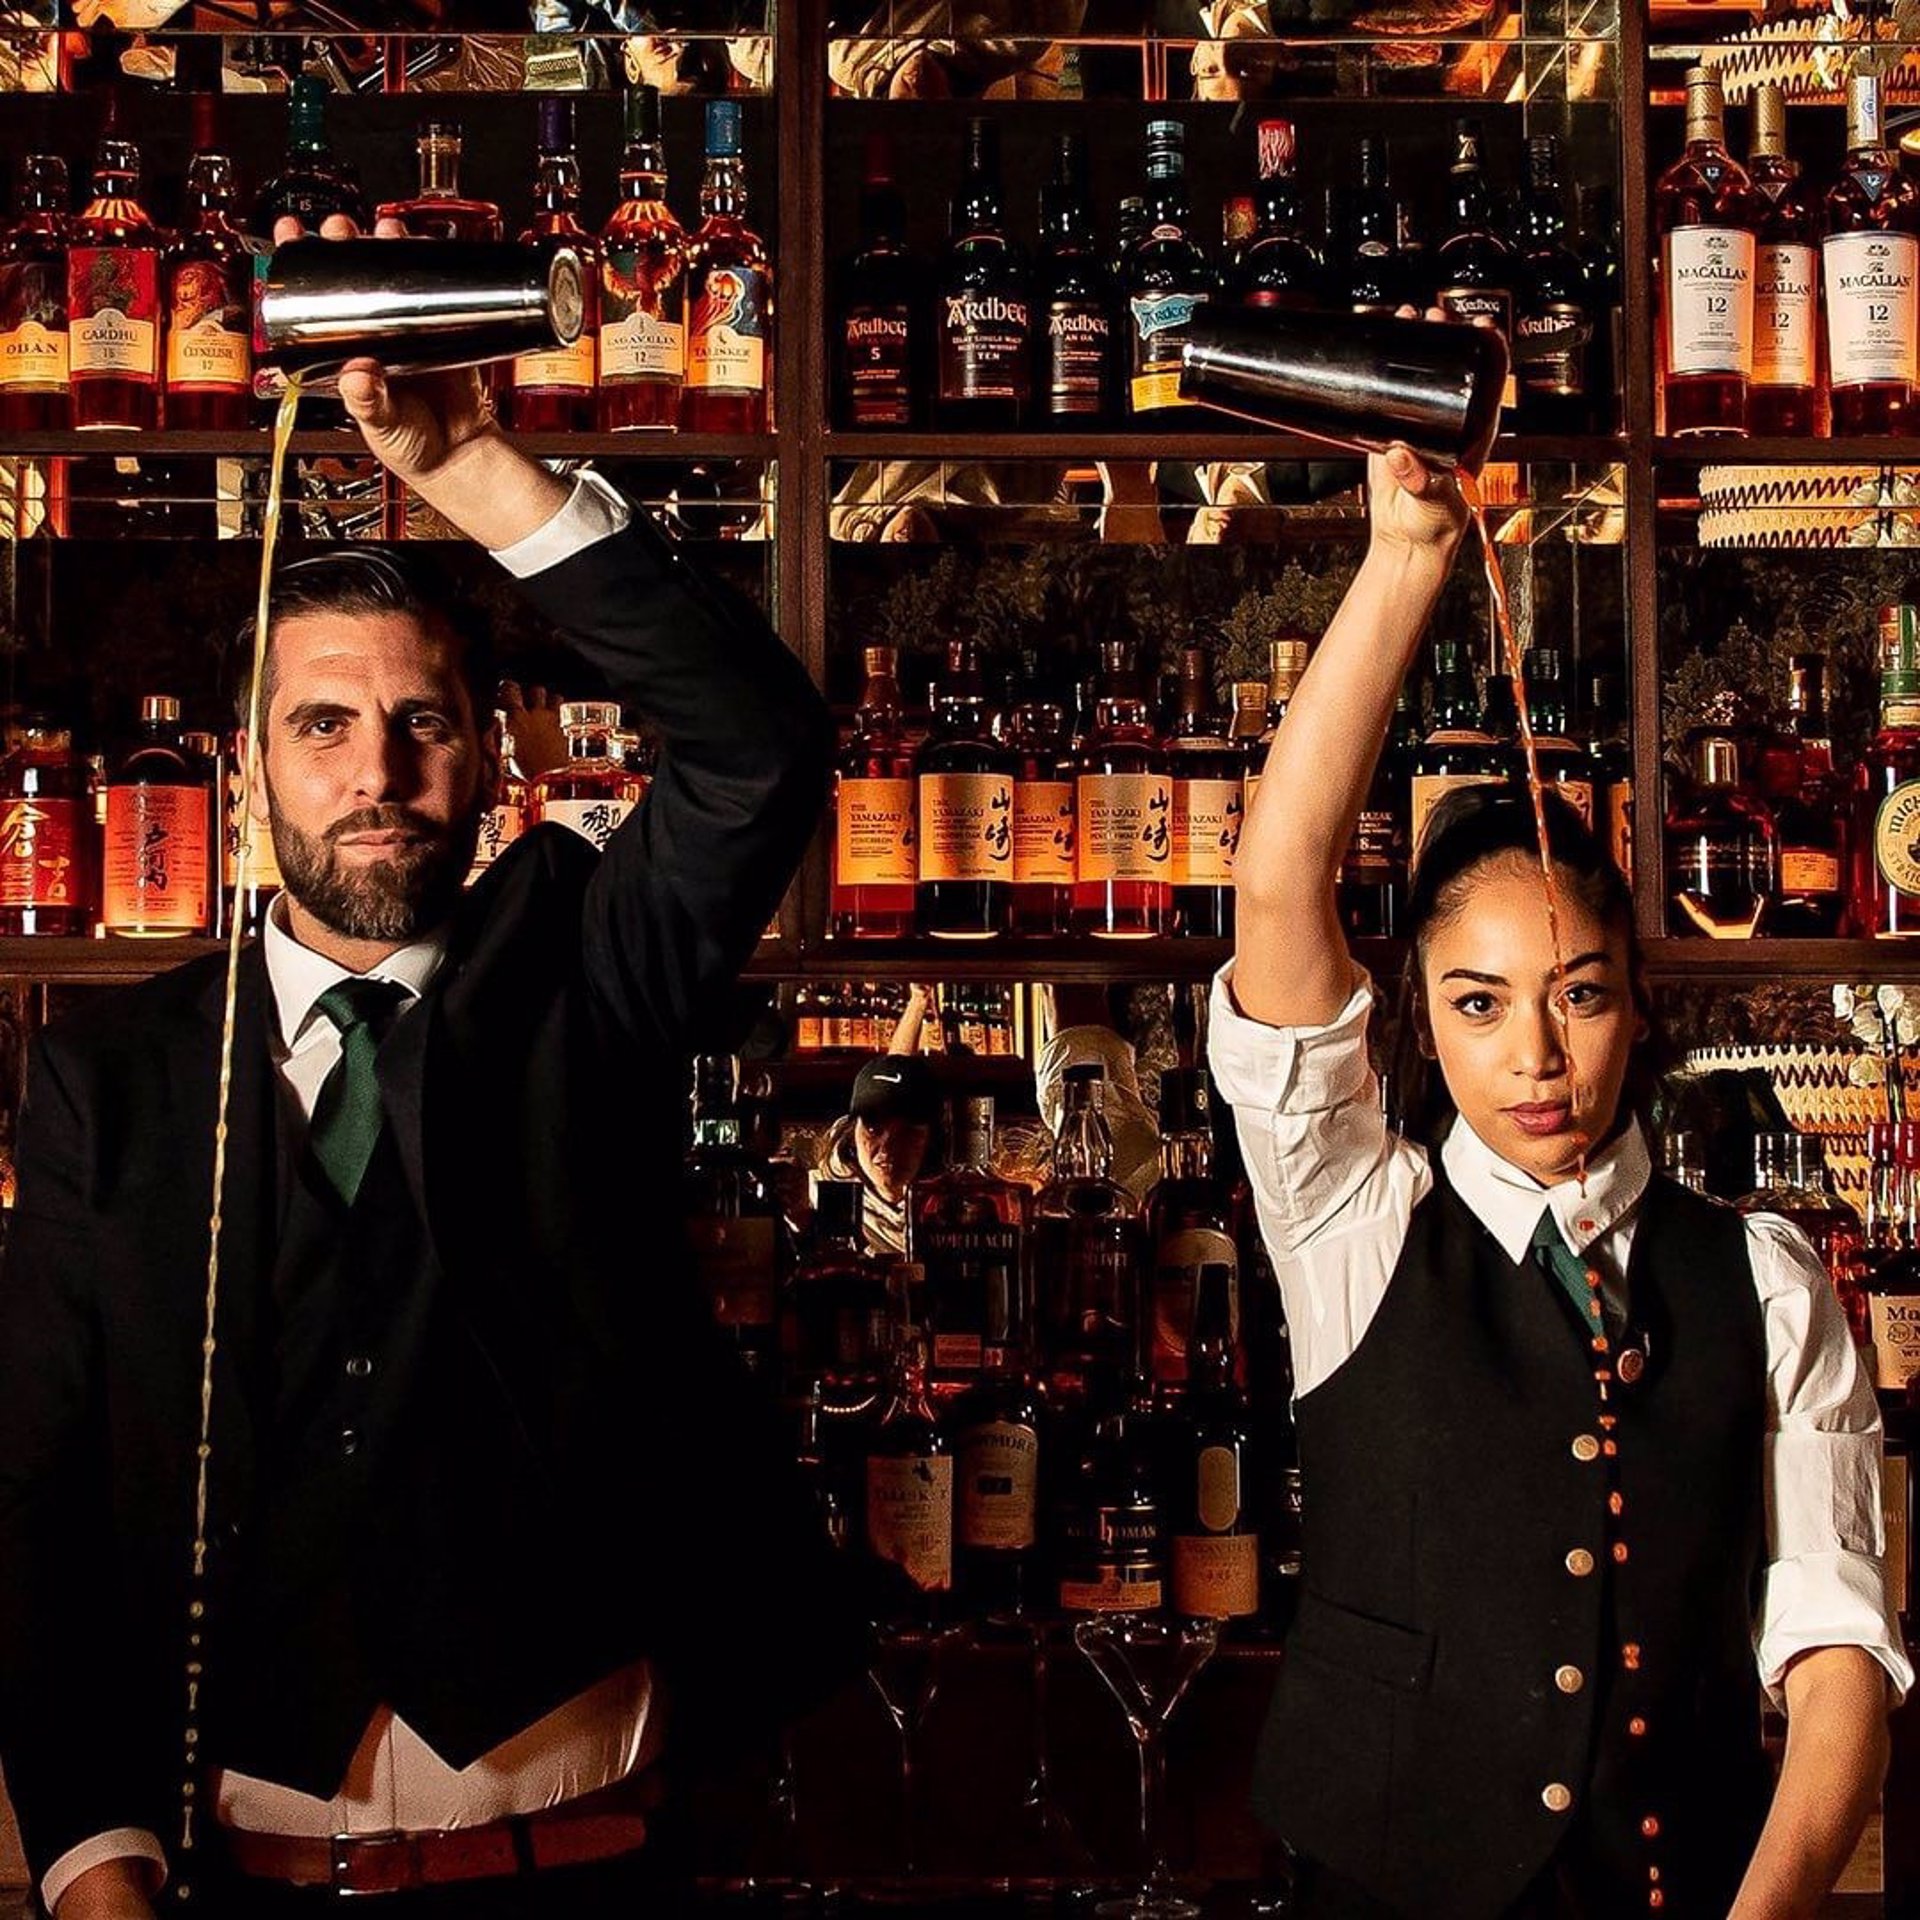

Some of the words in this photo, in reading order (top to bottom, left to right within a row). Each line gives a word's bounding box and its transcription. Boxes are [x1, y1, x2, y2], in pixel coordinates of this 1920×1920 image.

[1865, 173, 1882, 186] 12
[1678, 266, 1748, 281] MACALLAN
[1839, 275, 1912, 288] MACALLAN
[945, 295, 1027, 328] Ardbeg
[1707, 297, 1727, 313] 12
[1868, 304, 1889, 321] 12
[1048, 313, 1109, 336] Ardbeg
[1768, 312, 1790, 328] 12
[81, 328, 139, 343] CARDHU
[846, 316, 908, 340] Ardbeg
[6, 342, 59, 355] OBAN
[634, 351, 647, 363] 12
